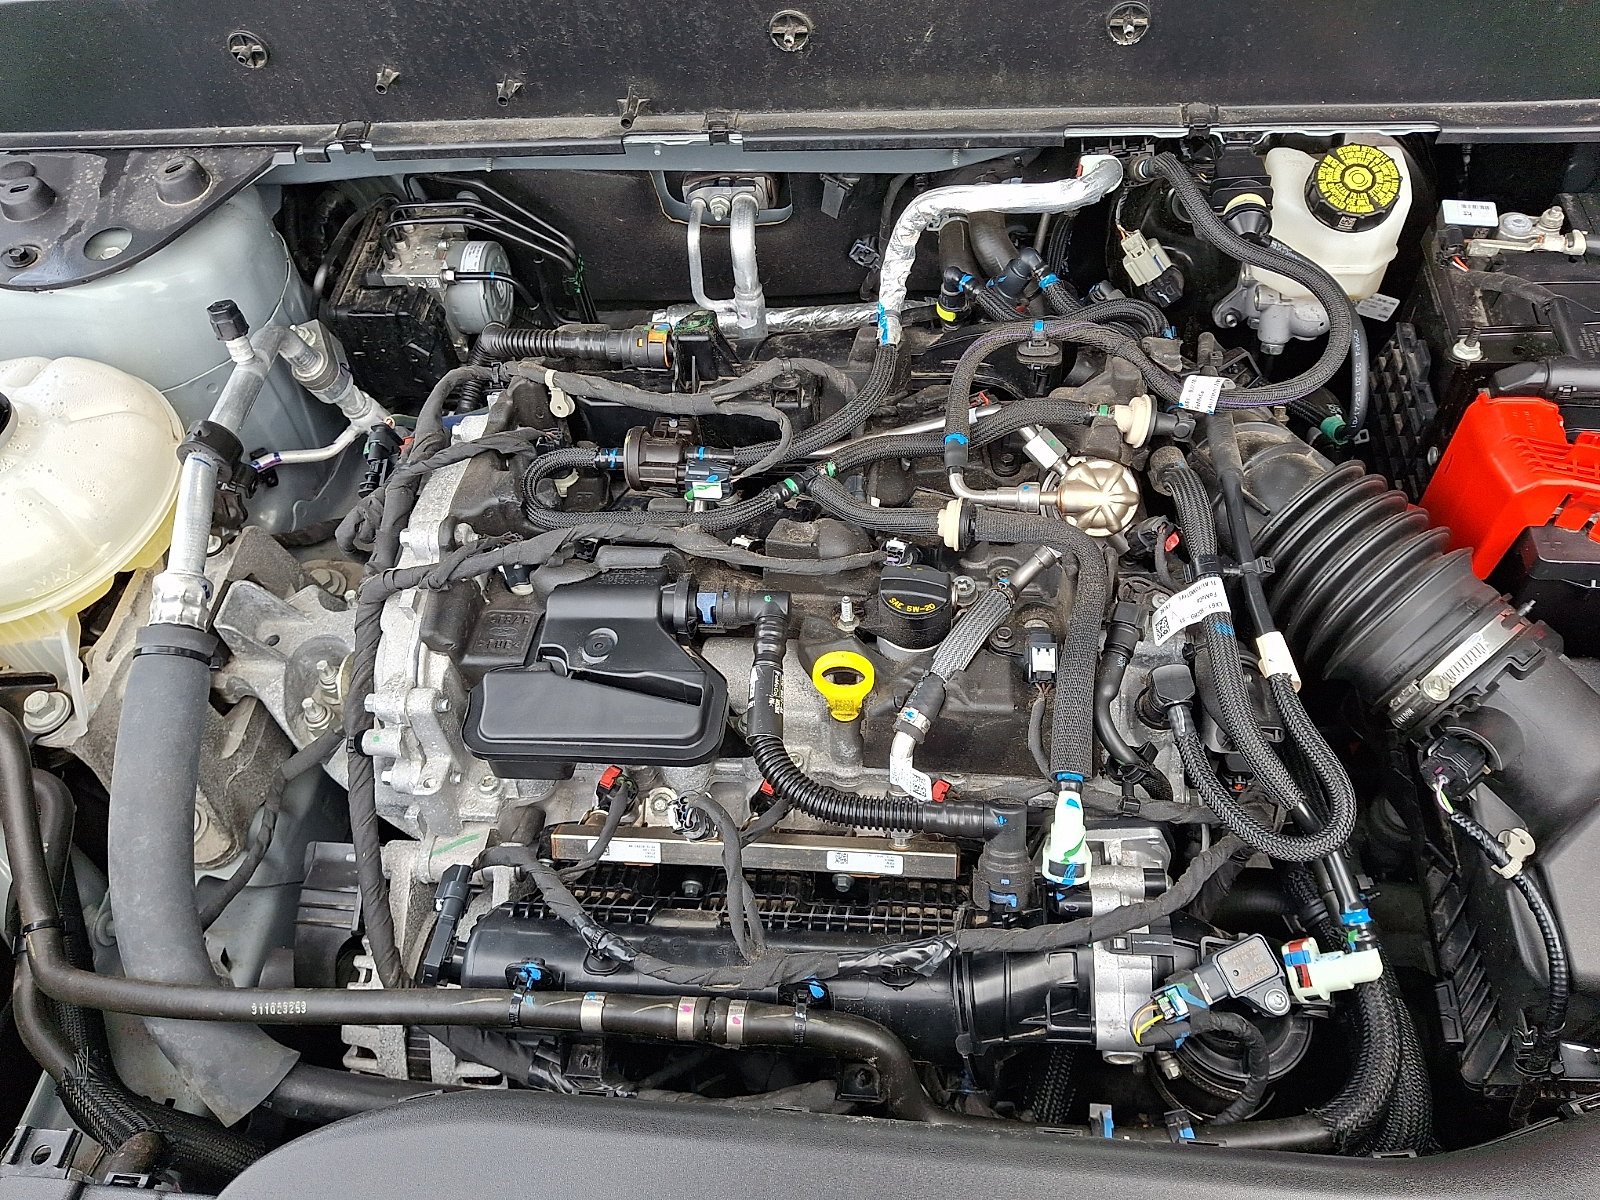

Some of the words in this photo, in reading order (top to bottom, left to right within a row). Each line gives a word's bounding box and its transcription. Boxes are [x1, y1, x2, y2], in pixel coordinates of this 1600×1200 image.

[888, 597, 905, 610] SAE
[906, 602, 936, 613] 5W-20
[1196, 592, 1218, 604] FoMoCo
